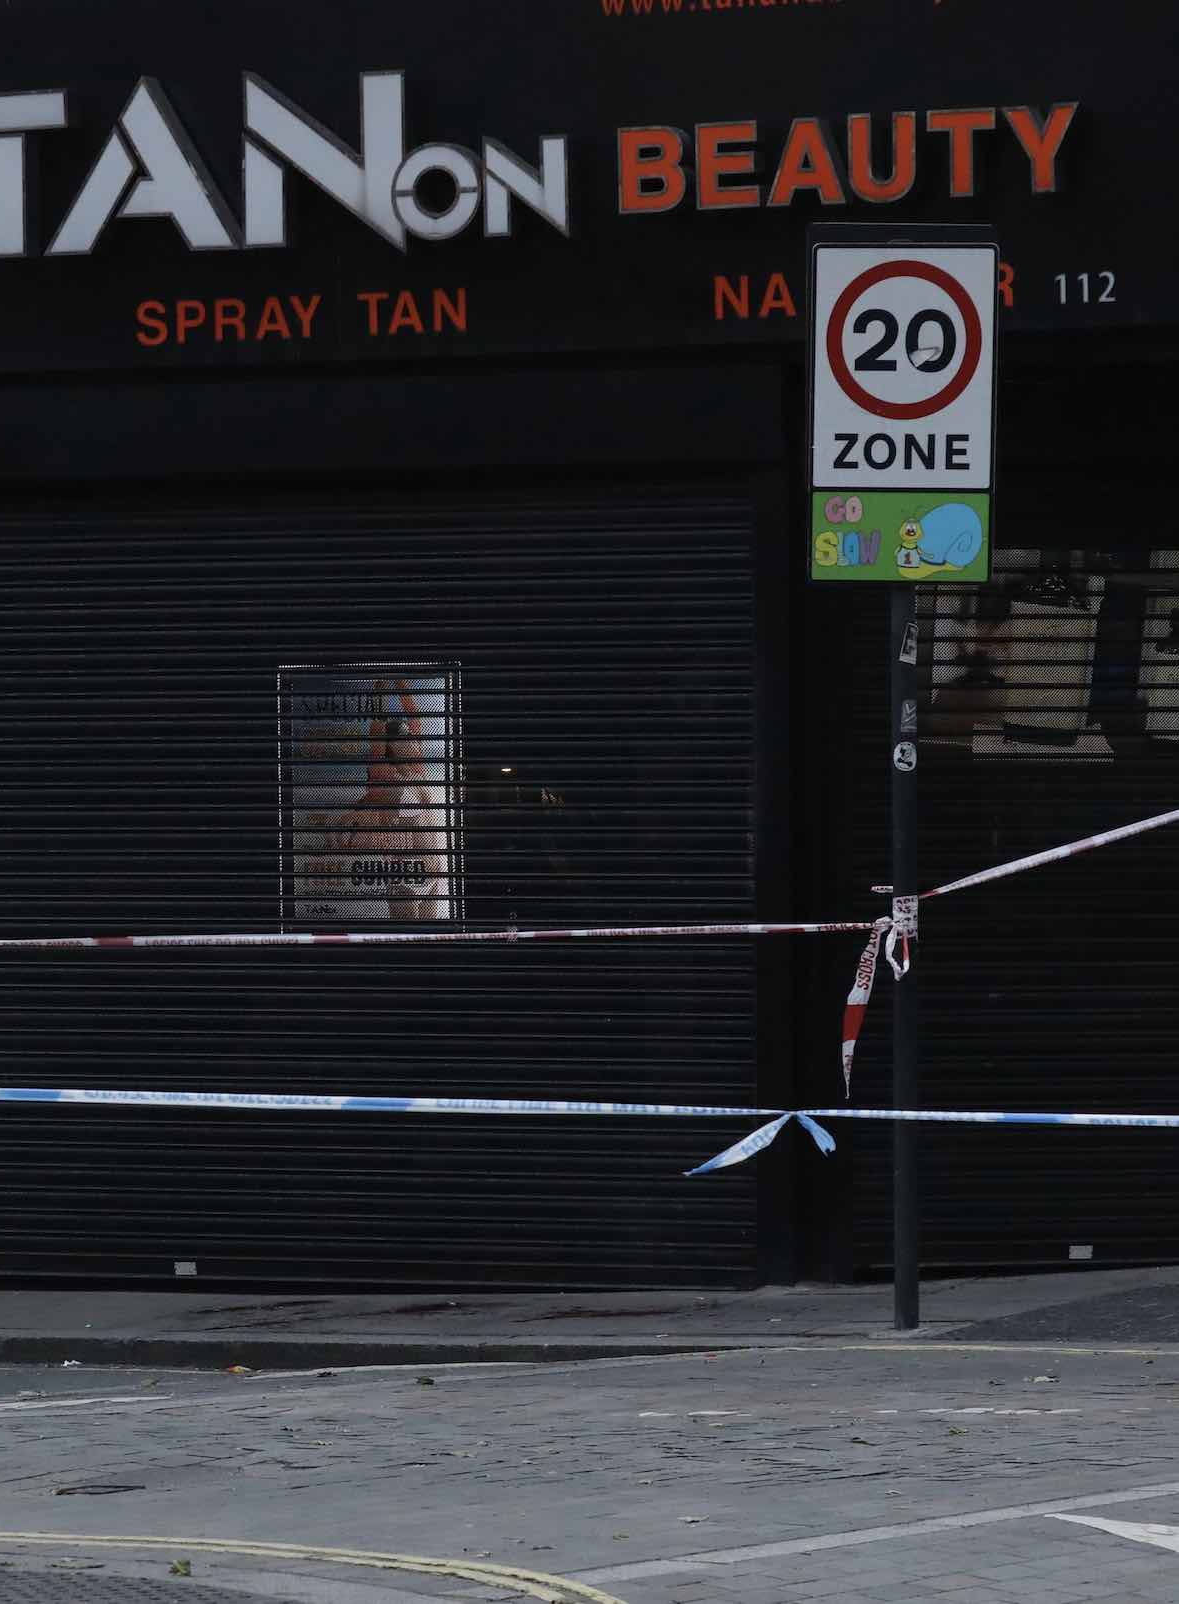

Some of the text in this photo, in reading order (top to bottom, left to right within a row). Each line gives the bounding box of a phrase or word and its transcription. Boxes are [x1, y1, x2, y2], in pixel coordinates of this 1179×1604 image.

[617, 102, 1079, 214] BEAUTY
[714, 272, 797, 320] NA
[1054, 271, 1117, 305] 112
[135, 288, 468, 347] SPRAY TAN
[852, 308, 957, 373] 20
[833, 432, 971, 471] ZONE
[815, 530, 881, 567] SLOW
